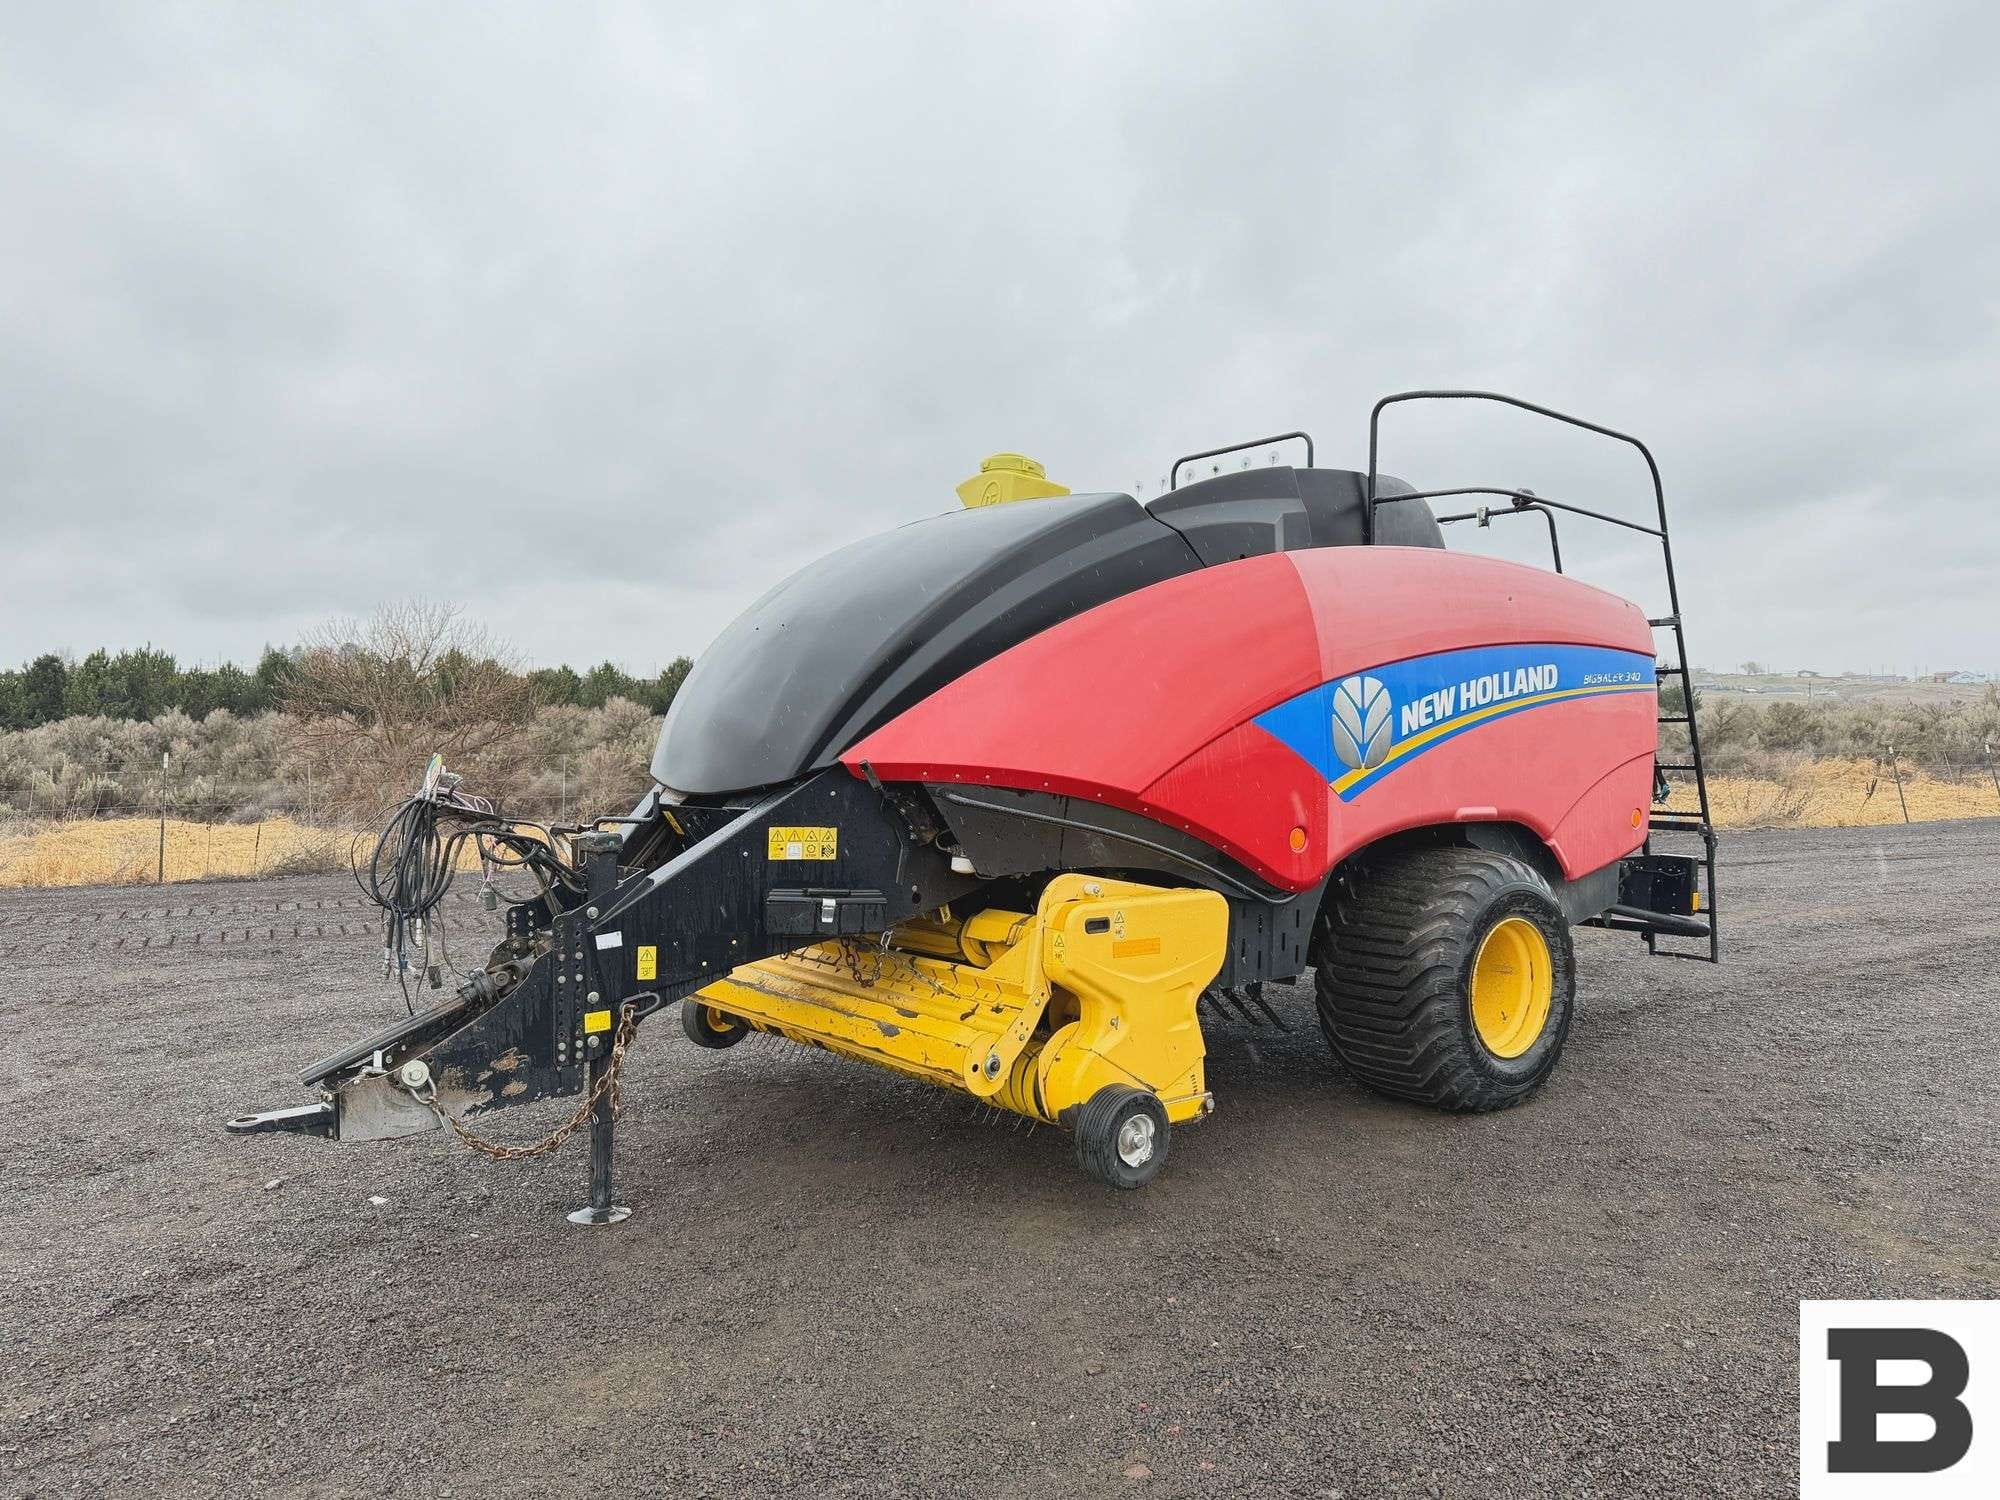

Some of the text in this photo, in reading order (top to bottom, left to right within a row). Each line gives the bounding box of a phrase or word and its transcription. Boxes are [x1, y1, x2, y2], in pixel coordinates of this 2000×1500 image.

[1401, 663, 1559, 737] NEW HOLLAND
[1583, 671, 1641, 685] BIGBALER 340
